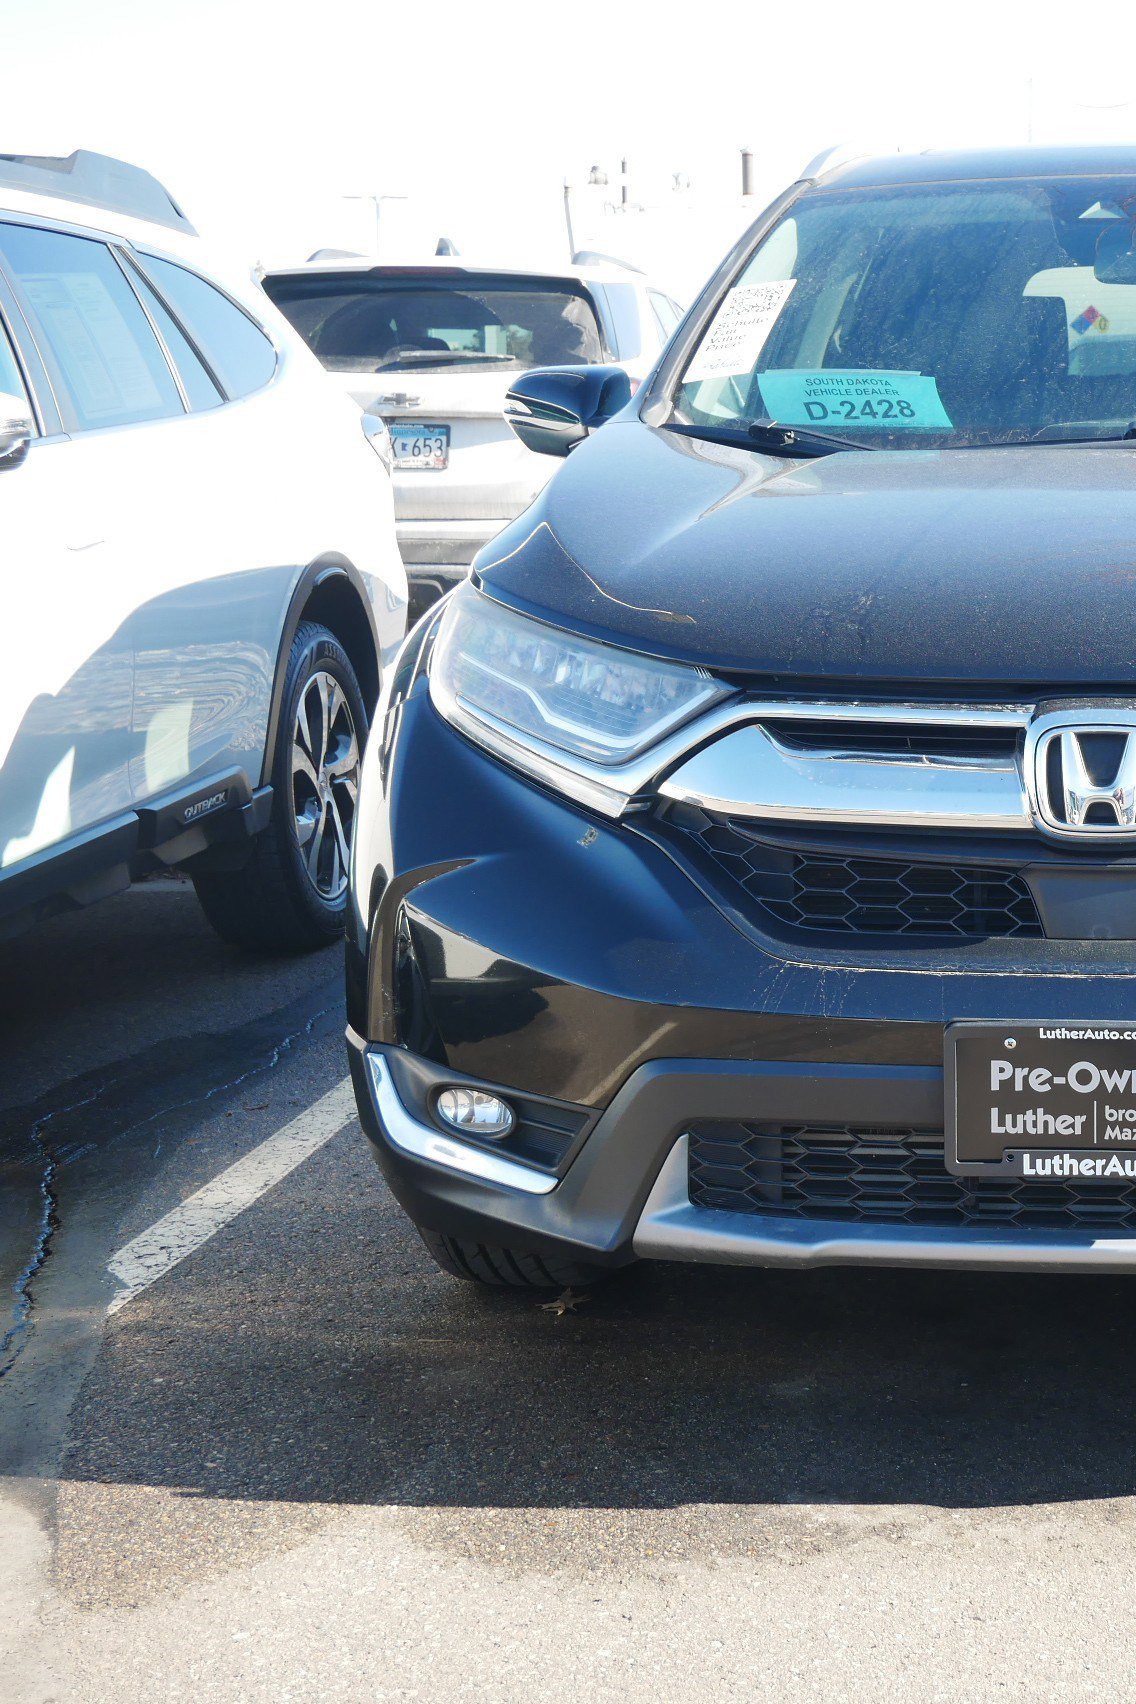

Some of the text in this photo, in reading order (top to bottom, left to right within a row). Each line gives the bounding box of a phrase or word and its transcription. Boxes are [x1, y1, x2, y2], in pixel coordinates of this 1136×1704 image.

[804, 388, 900, 397] VEHICLE DEALER
[805, 378, 892, 387] SOUTH DAKOTA
[803, 399, 916, 421] D-2428
[412, 437, 443, 457] 653
[184, 791, 226, 819] OUTBACK
[990, 1107, 1087, 1135] Luther
